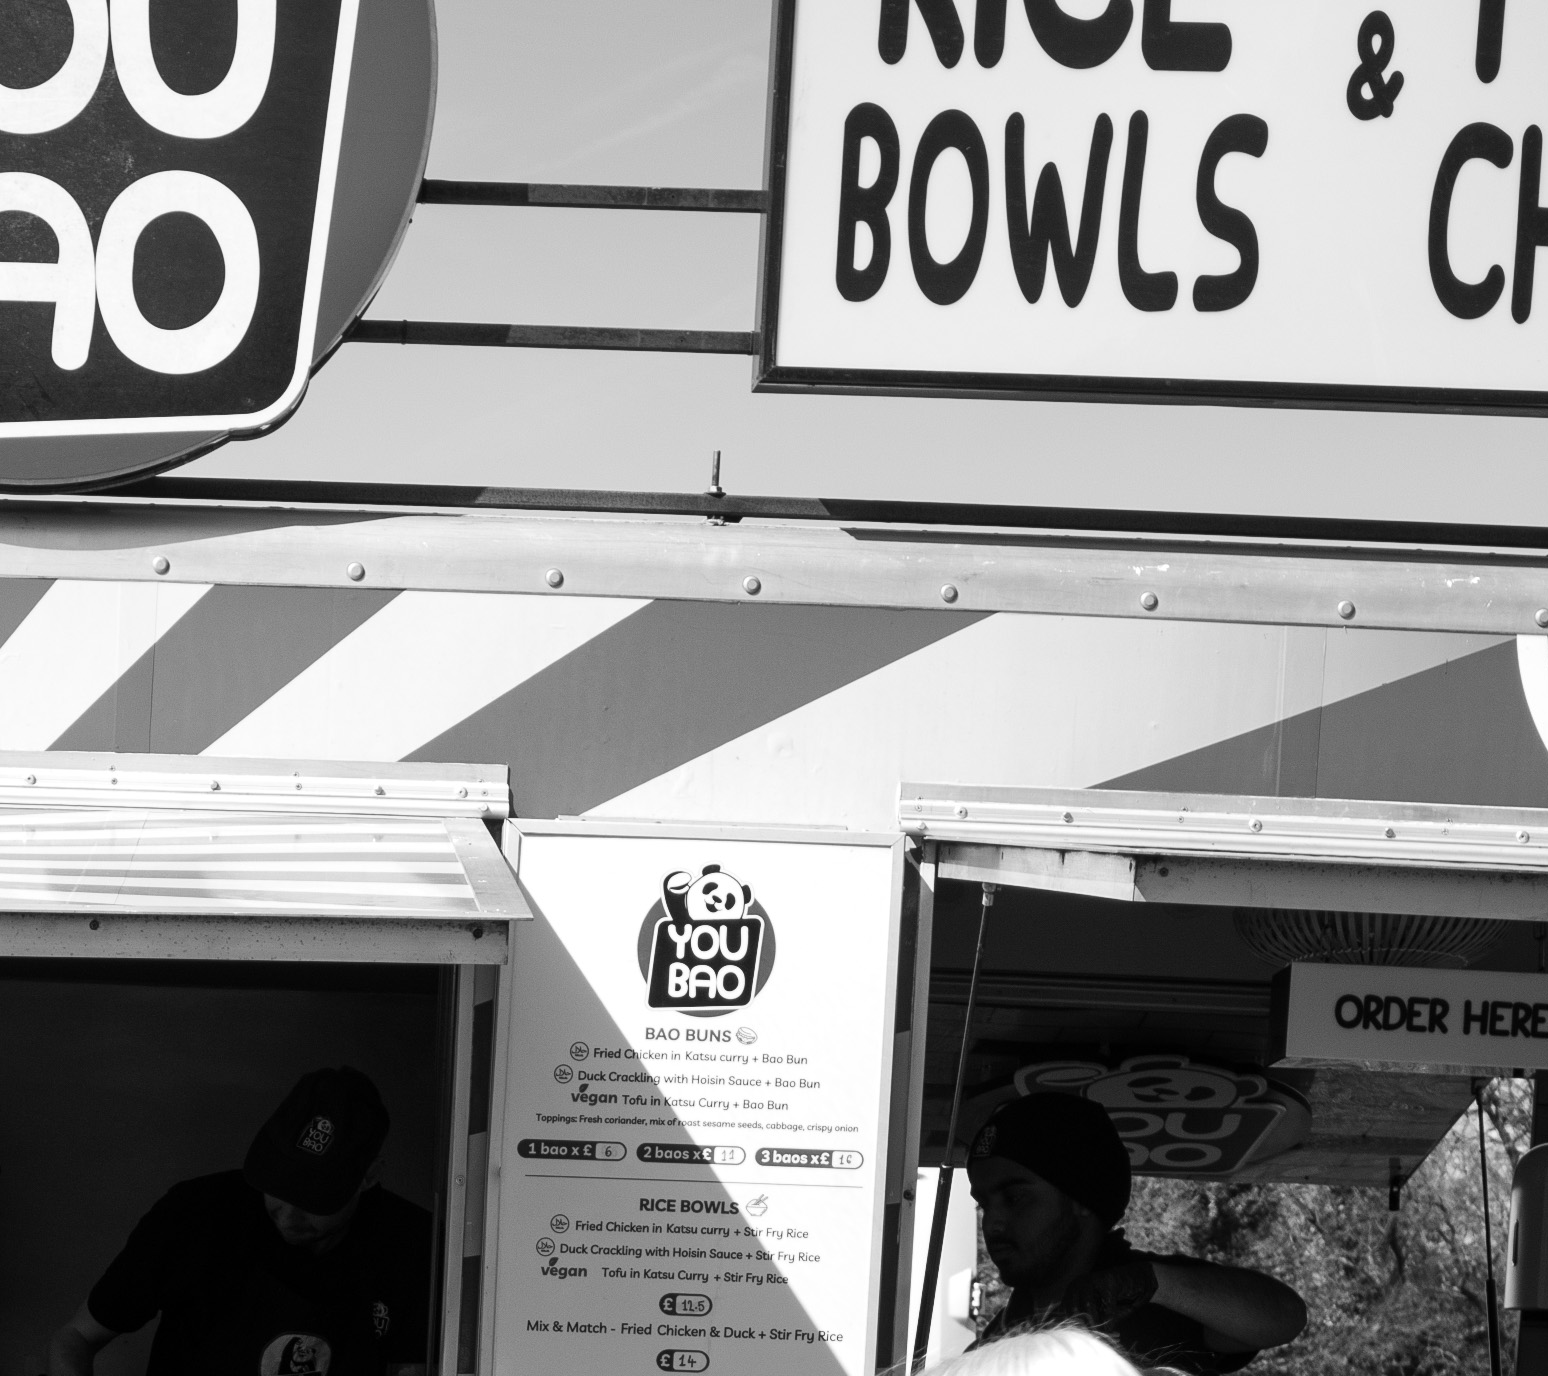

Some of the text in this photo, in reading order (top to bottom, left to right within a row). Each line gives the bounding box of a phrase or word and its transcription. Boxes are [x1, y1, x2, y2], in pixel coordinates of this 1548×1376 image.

[1348, 12, 1405, 121] &
[837, 104, 1269, 313] BOWLS
[667, 923, 749, 961] YOU
[667, 962, 745, 1000] BAO
[1334, 994, 1450, 1034] ORDER
[645, 1027, 731, 1042] BAO BUNS
[593, 1048, 621, 1059] Fried
[624, 1049, 667, 1059] Chicken
[686, 1052, 716, 1061] Katsu
[720, 1055, 748, 1065] curry
[762, 1054, 783, 1063] Bao
[786, 1055, 807, 1064] Bun
[1104, 1111, 1243, 1141] OU
[528, 1143, 536, 1154] 1
[541, 1143, 568, 1156] bao
[571, 1146, 579, 1156] x
[583, 1144, 592, 1156] £
[643, 1146, 652, 1158] 2
[655, 1146, 689, 1160] baos
[761, 1150, 771, 1163] 3
[772, 1150, 808, 1164] baos
[639, 1198, 739, 1214] RICE BOWLS
[575, 1220, 603, 1231] Fried
[605, 1222, 649, 1233] Chicken
[652, 1223, 662, 1233] in
[666, 1224, 698, 1234] Katsu
[700, 1227, 730, 1238] curry
[743, 1227, 762, 1237] Stir
[766, 1228, 783, 1239] Fry
[787, 1229, 808, 1238] Rice
[663, 1297, 705, 1312] £ 12.5
[527, 1320, 549, 1331] Mix
[567, 1322, 607, 1333] Match
[621, 1323, 652, 1335] Fried
[657, 1324, 706, 1337] Chicken
[724, 1327, 756, 1339] Duck
[769, 1328, 792, 1340] Stir
[795, 1329, 815, 1344] Fry
[818, 1331, 843, 1342] Rice
[660, 1353, 697, 1368] £ 14
